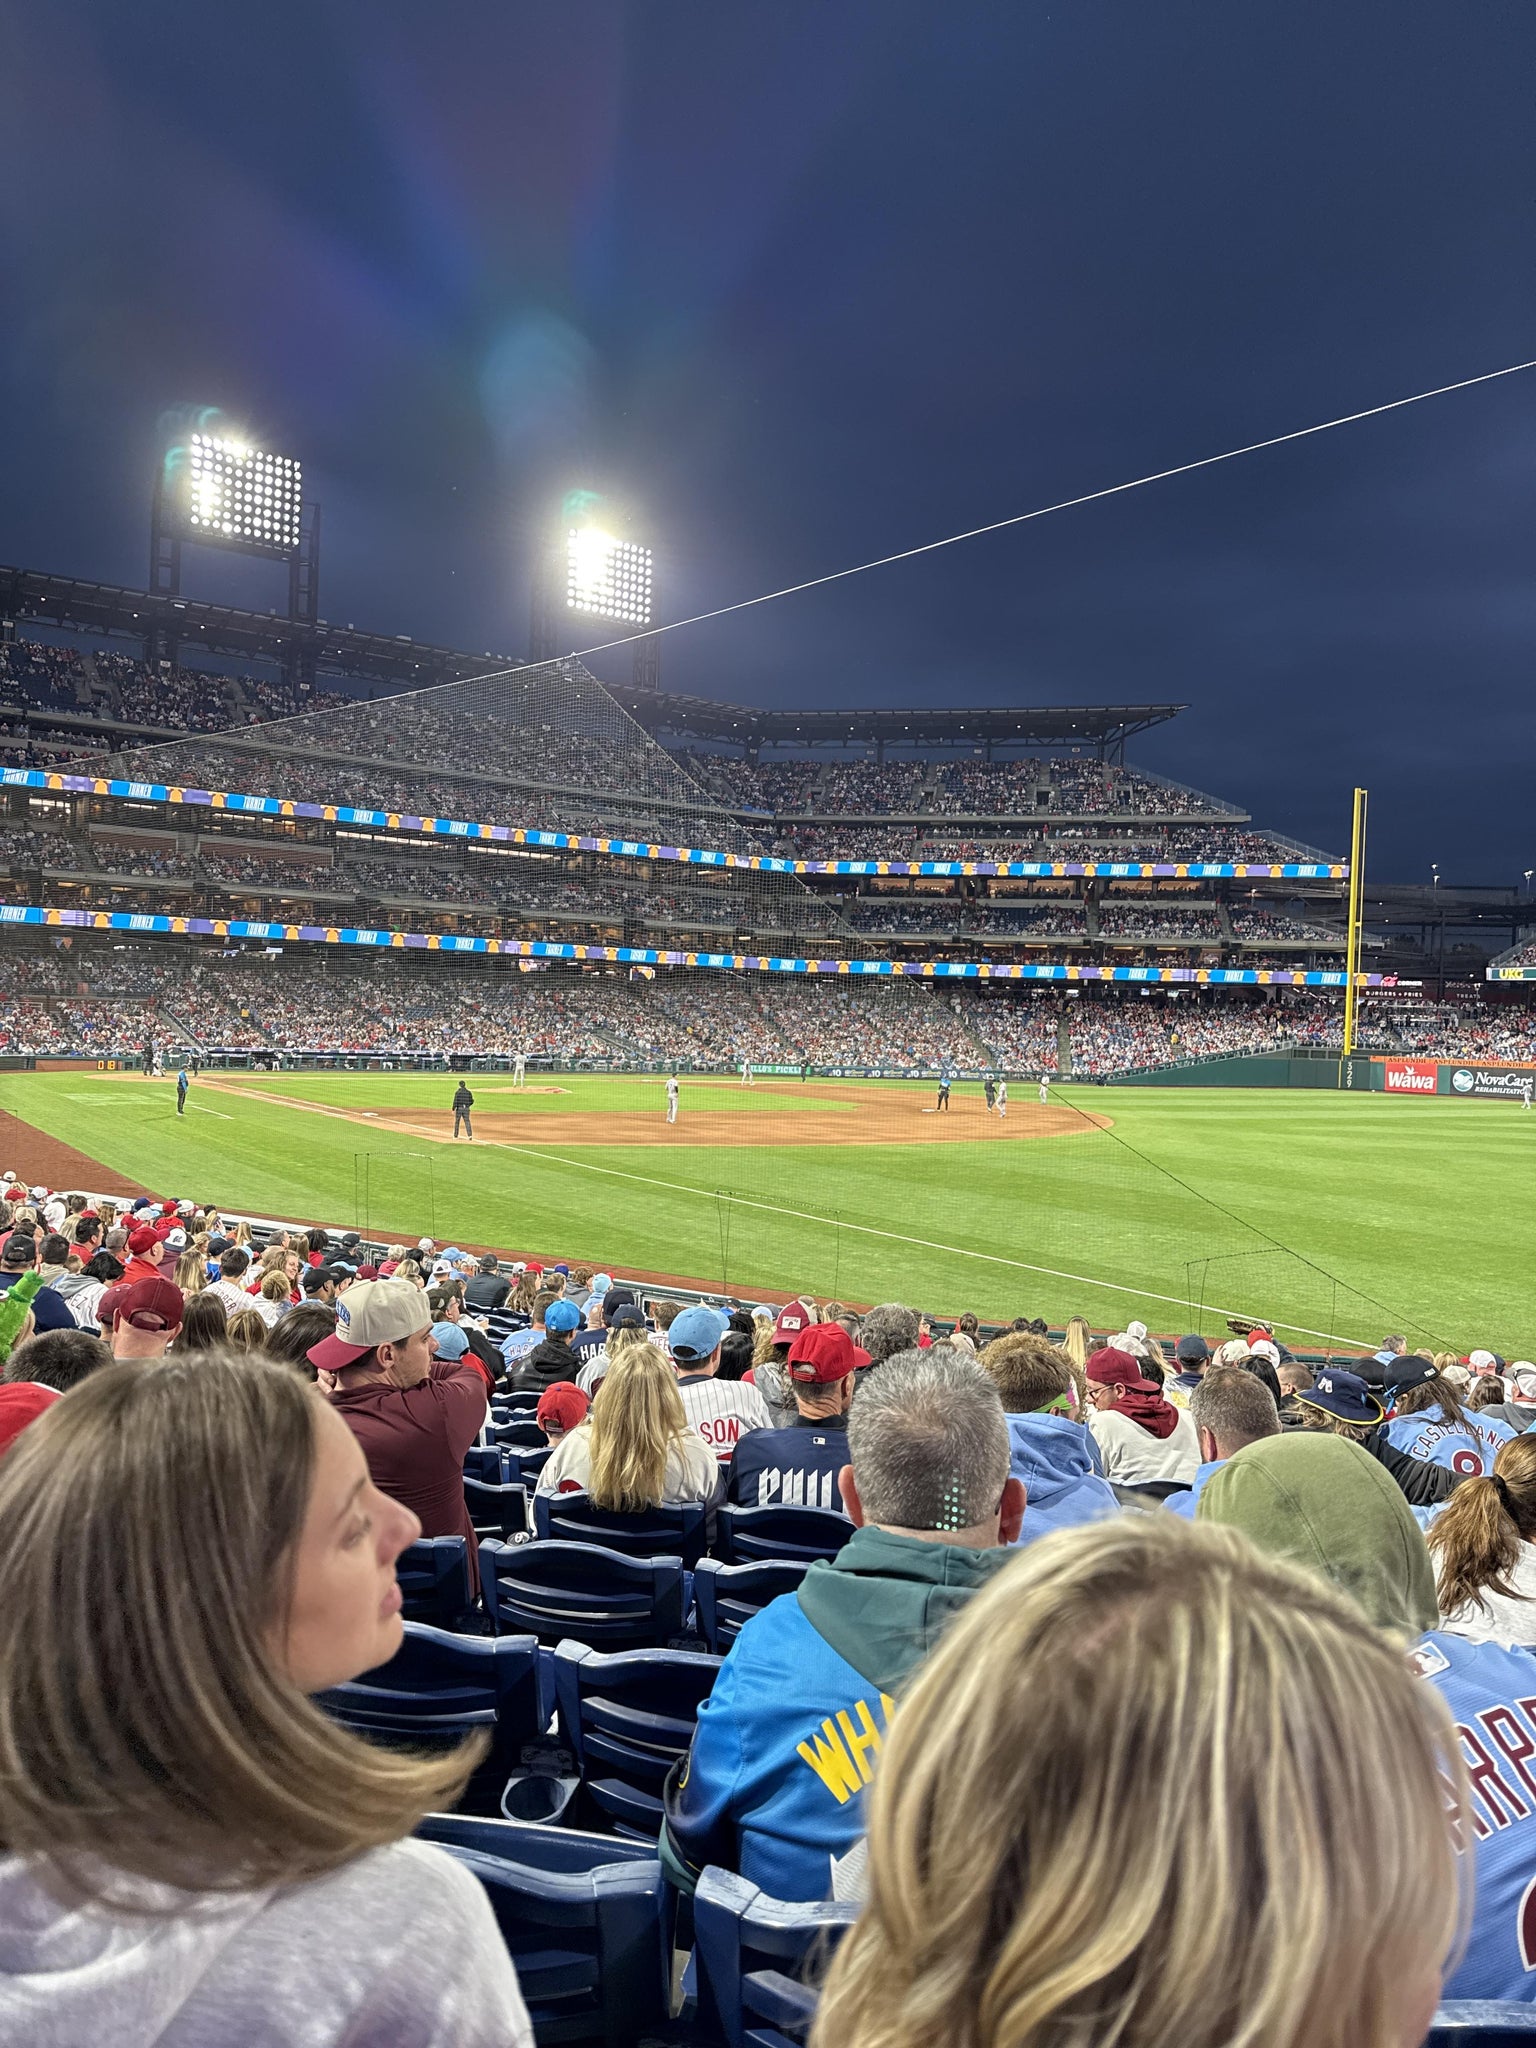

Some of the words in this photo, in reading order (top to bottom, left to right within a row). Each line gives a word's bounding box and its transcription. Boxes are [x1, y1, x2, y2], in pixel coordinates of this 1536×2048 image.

[0, 906, 27, 921] TURNER
[129, 914, 155, 930] TURNER
[246, 922, 270, 937] TURNER
[1499, 968, 1524, 979] UKG
[1388, 1071, 1435, 1089] Wawa
[1475, 1072, 1533, 1086] NovaCare
[700, 1418, 740, 1445] SON
